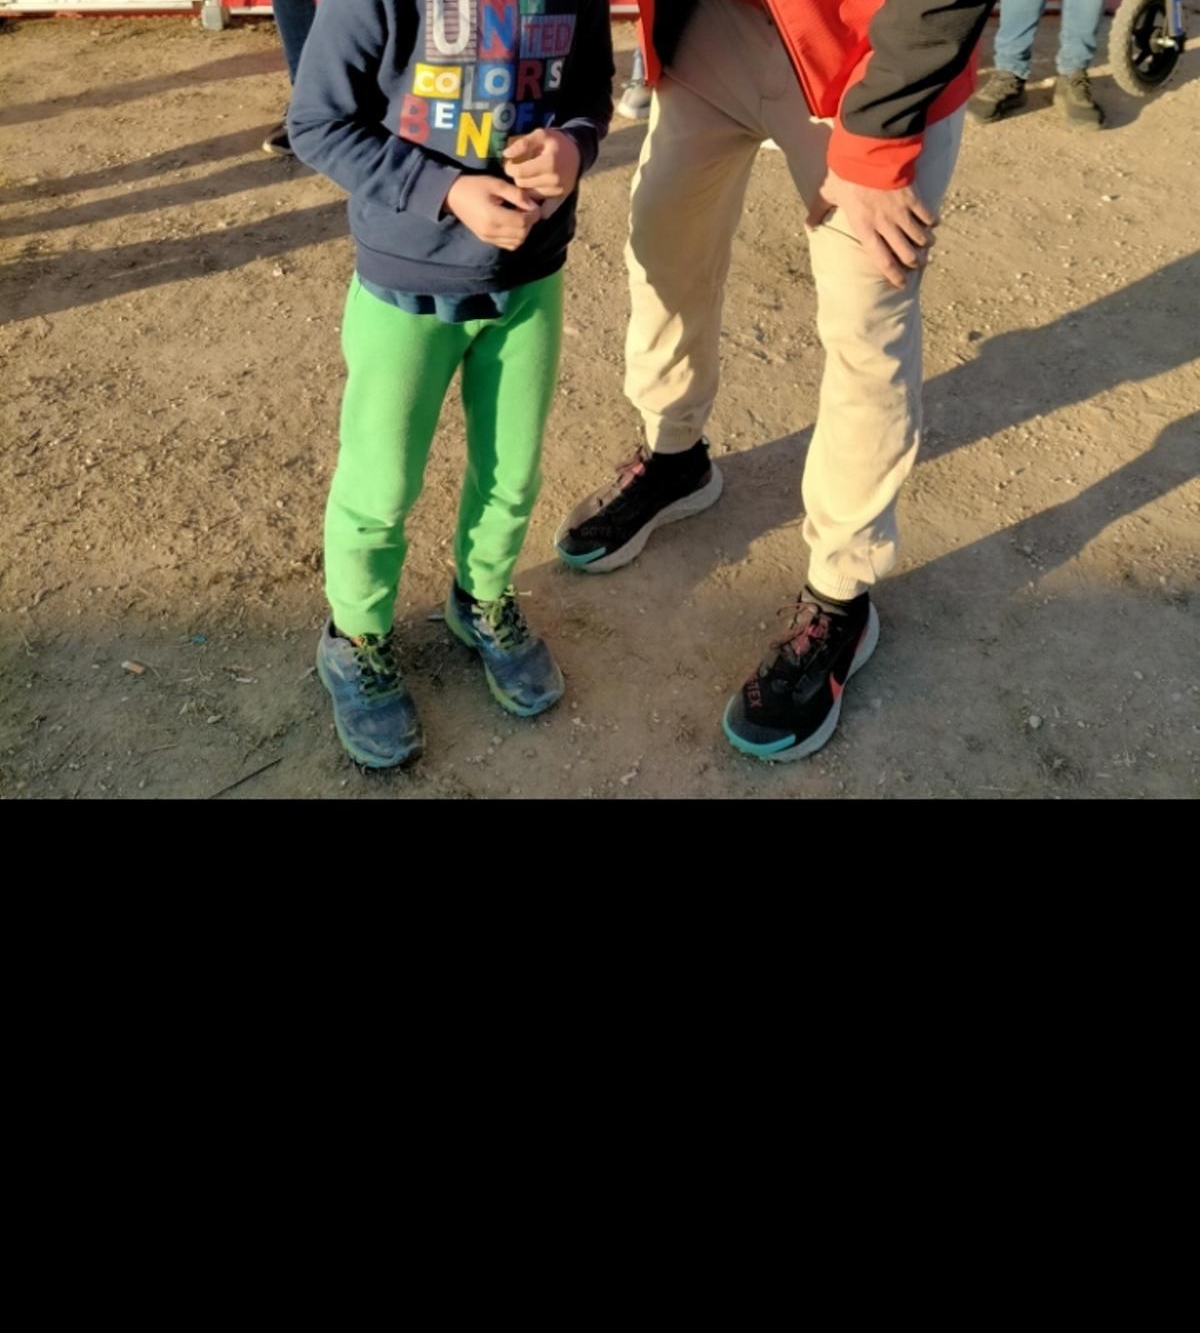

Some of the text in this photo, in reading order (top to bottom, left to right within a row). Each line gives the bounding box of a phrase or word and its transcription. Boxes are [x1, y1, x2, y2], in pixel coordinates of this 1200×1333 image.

[414, 61, 564, 110] COLORS
[399, 94, 508, 159] BENE
[493, 102, 534, 132] OF
